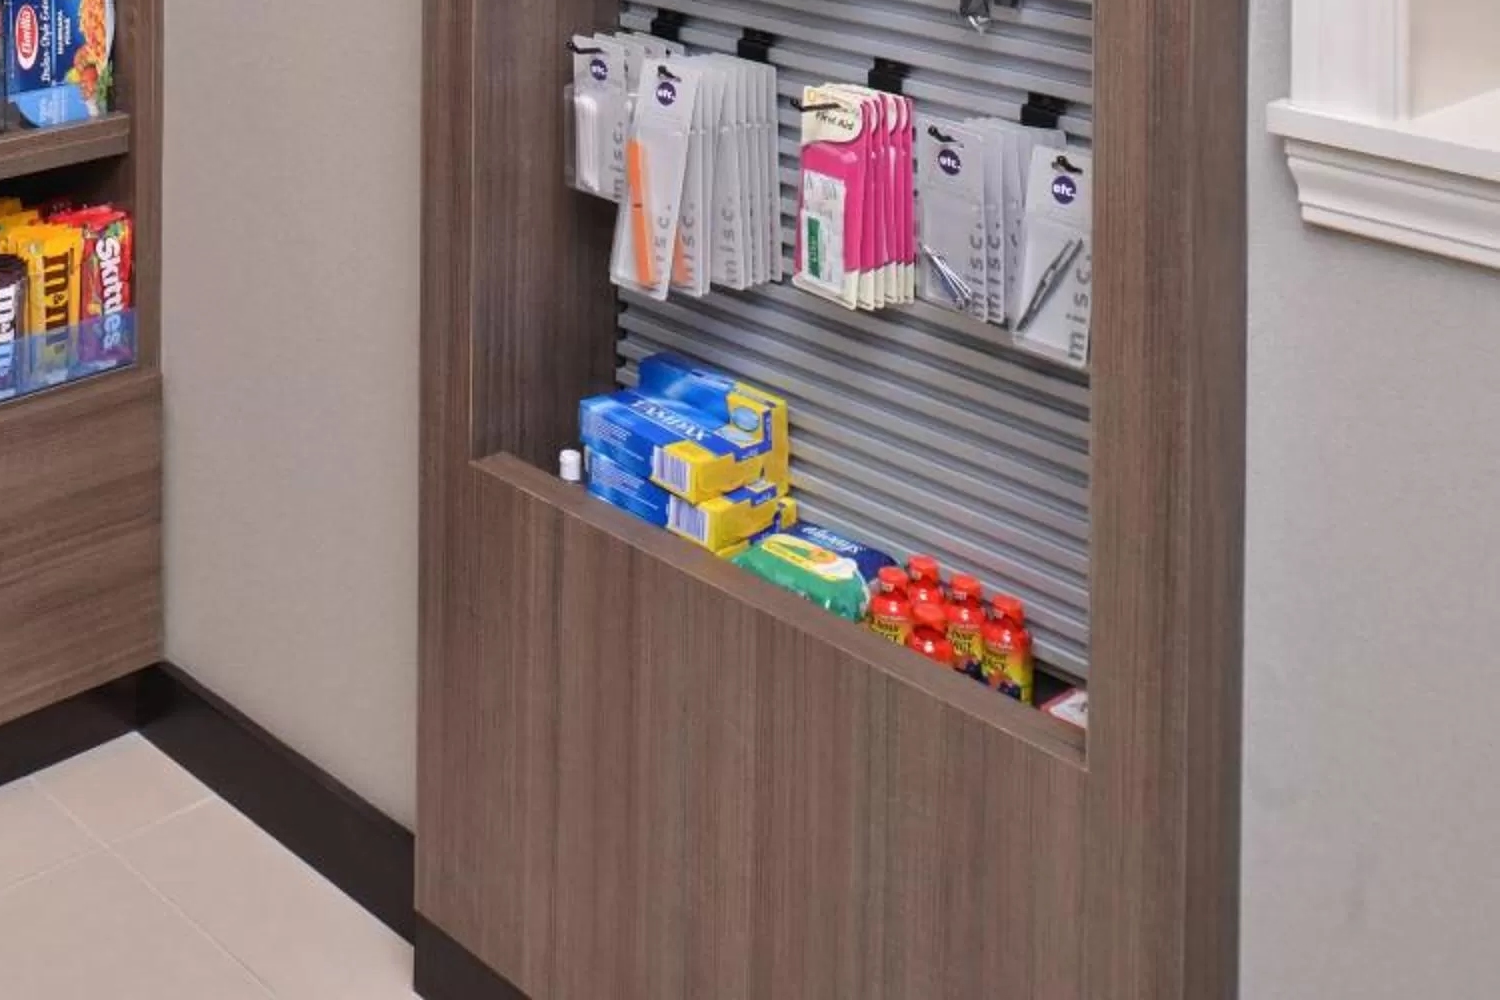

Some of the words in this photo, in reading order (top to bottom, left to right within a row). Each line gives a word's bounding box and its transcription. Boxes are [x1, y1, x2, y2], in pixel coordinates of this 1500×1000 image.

[1053, 182, 1077, 198] etc.
[96, 237, 124, 349] Skittles
[1066, 254, 1092, 361] misc.
